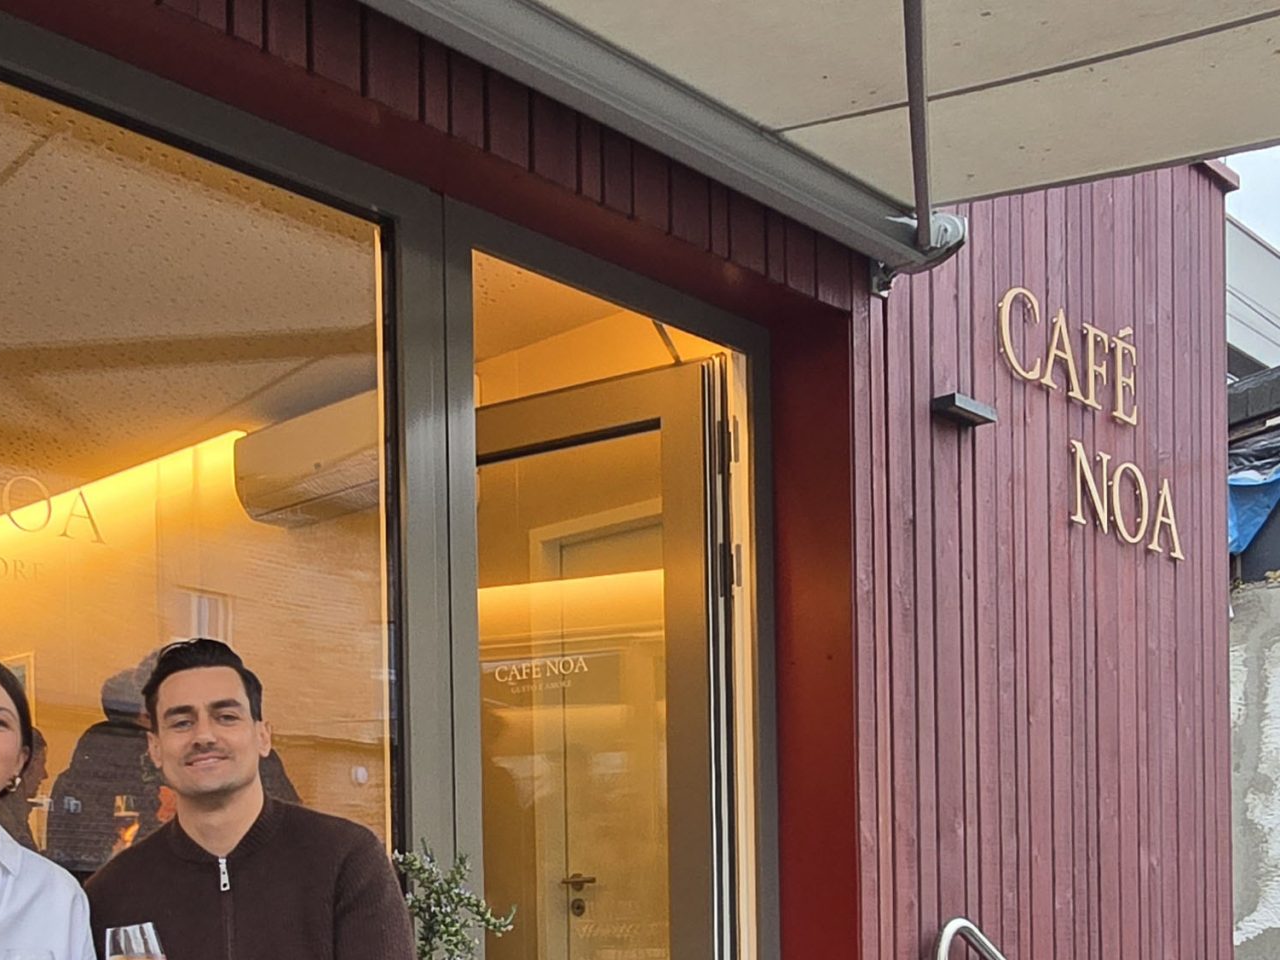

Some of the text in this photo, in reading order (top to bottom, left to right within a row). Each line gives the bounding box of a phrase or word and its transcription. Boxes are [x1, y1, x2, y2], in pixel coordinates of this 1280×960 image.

[998, 286, 1138, 426] CAFÉ
[1070, 438, 1185, 561] NOA
[546, 655, 589, 677] NOA
